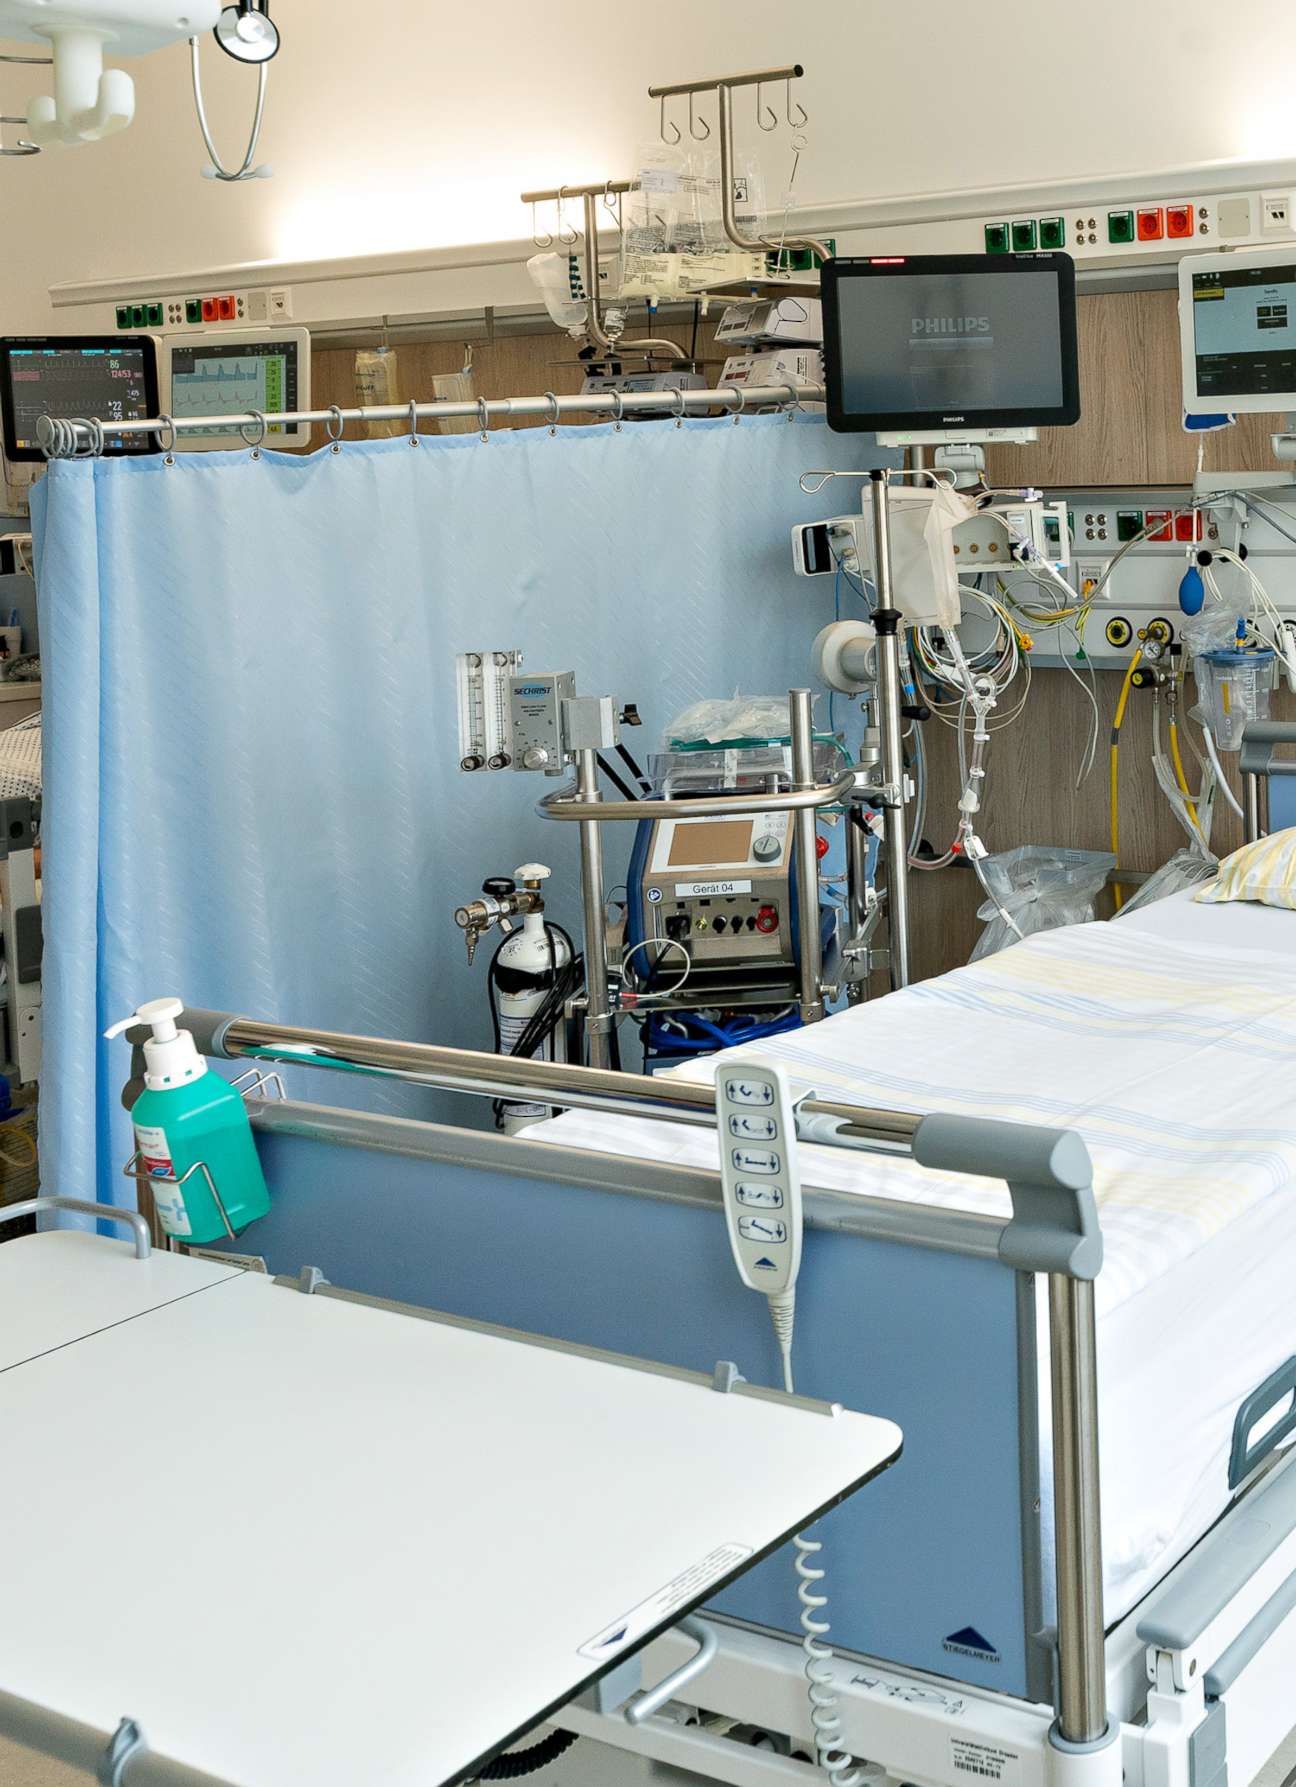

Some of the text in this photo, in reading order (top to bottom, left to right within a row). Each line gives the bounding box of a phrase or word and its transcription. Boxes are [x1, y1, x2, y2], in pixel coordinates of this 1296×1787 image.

[912, 317, 989, 333] PHILIPS
[513, 686, 552, 696] SECHRIST
[692, 882, 734, 894] Gerät 04
